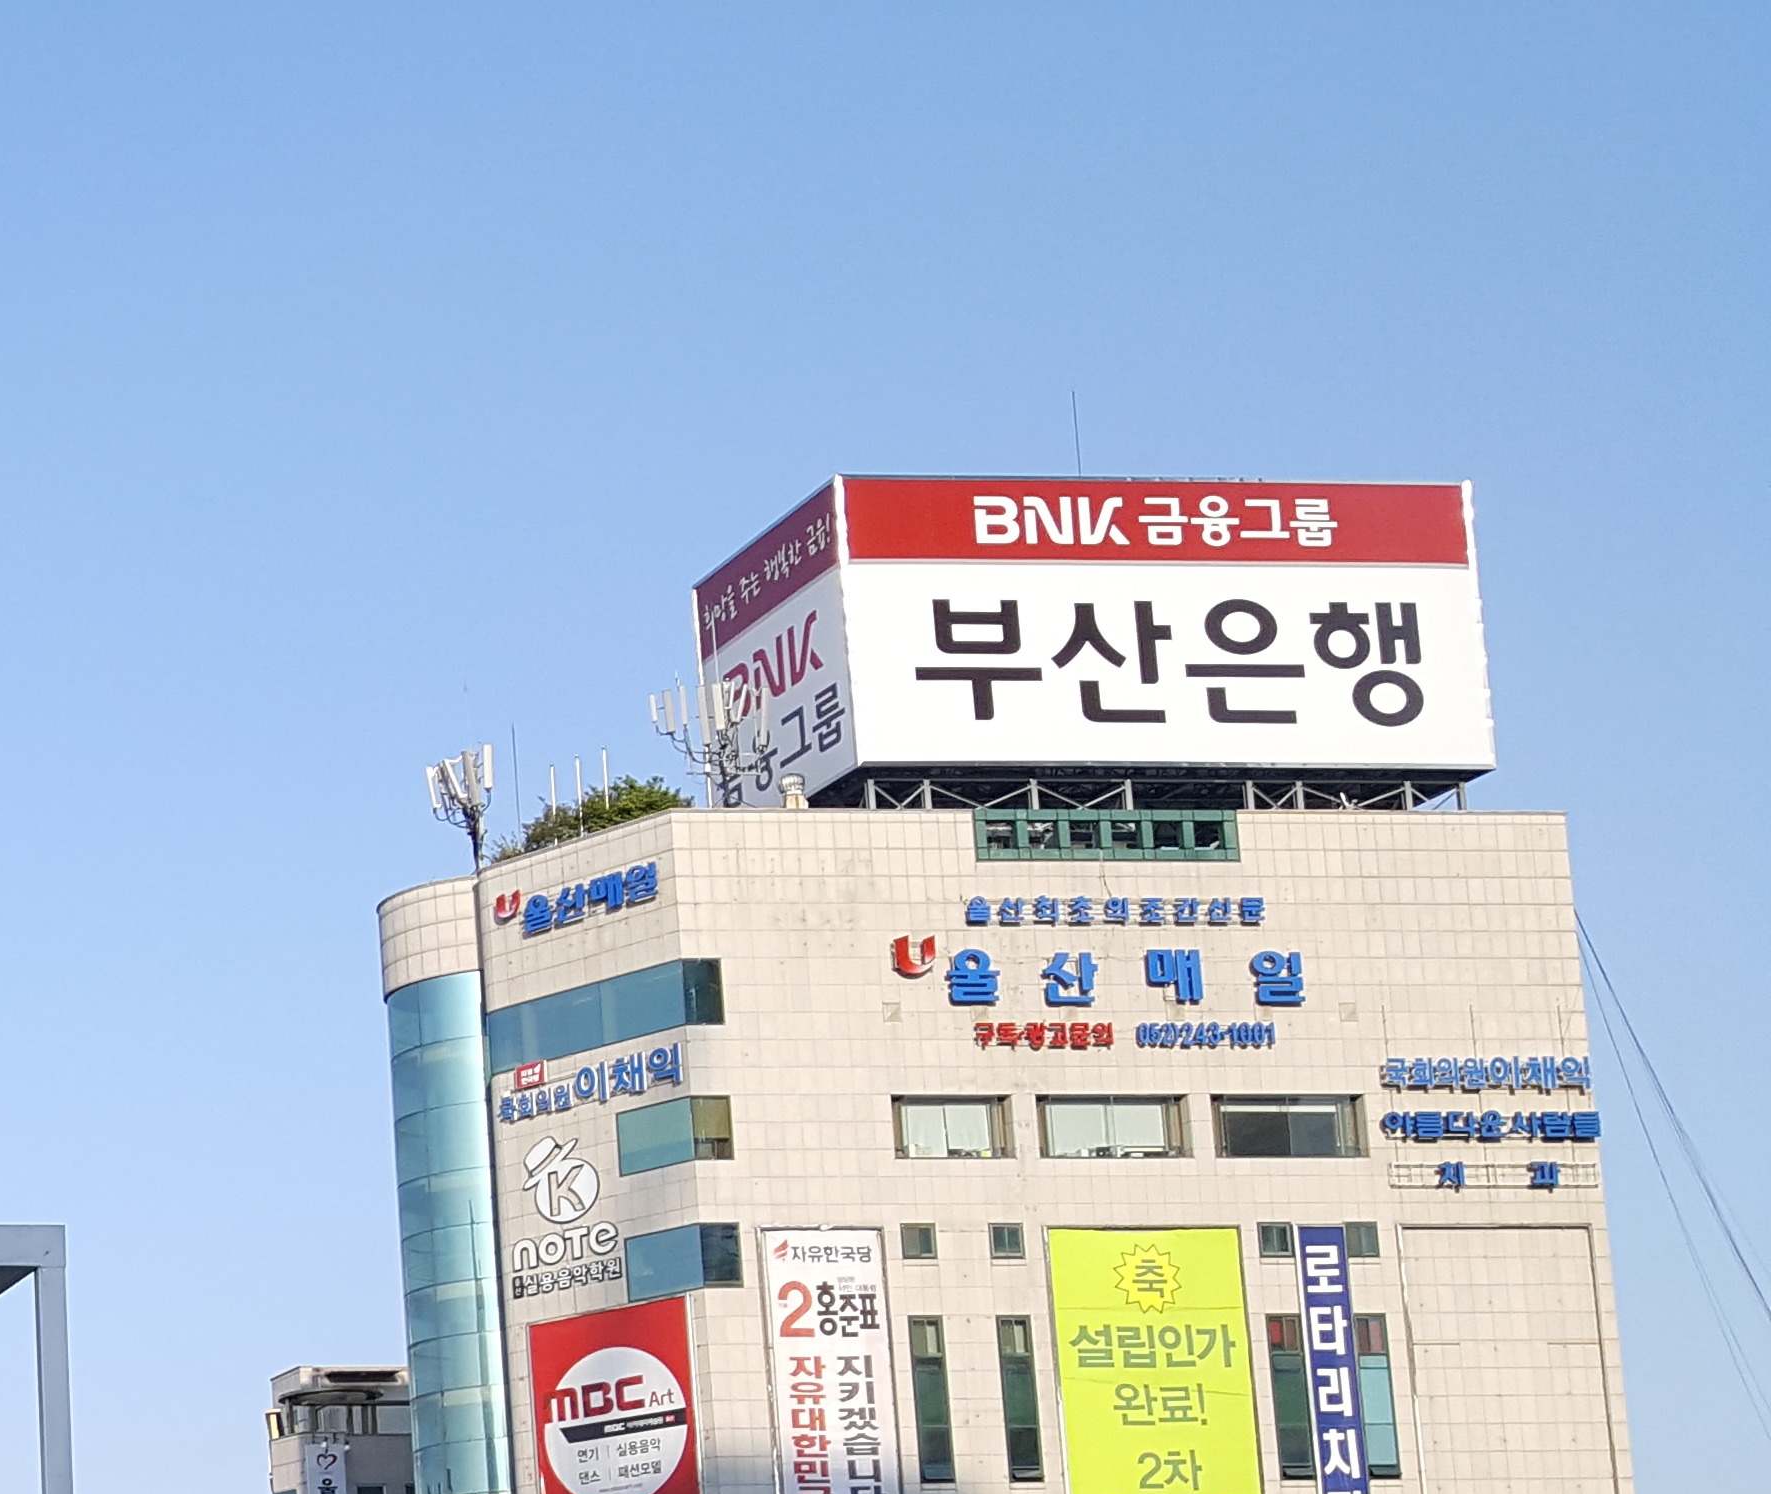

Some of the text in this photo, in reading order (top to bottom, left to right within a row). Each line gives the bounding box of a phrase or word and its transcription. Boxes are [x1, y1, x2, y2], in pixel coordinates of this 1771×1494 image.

[973, 495, 1338, 546] BNK 금융그룹
[703, 584, 738, 631] 희망을
[739, 572, 761, 605] 주는
[763, 539, 802, 581] 행복한
[915, 597, 1426, 727] 부산은행
[522, 862, 658, 935] 울산매일
[548, 1164, 586, 1217] K
[524, 1256, 623, 1296] 실용음악학원
[791, 1246, 872, 1263] 자유한국당
[1132, 1258, 1169, 1299] 축
[778, 1280, 880, 1337] 2 홍준표
[1069, 1323, 1237, 1368] 설립인가
[649, 1388, 675, 1408] Art
[1112, 1382, 1208, 1427] 완료!
[577, 1437, 661, 1464] 연기 실용음악
[578, 1459, 662, 1485] 댄스 패션모델
[1136, 1448, 1203, 1491] 2차
